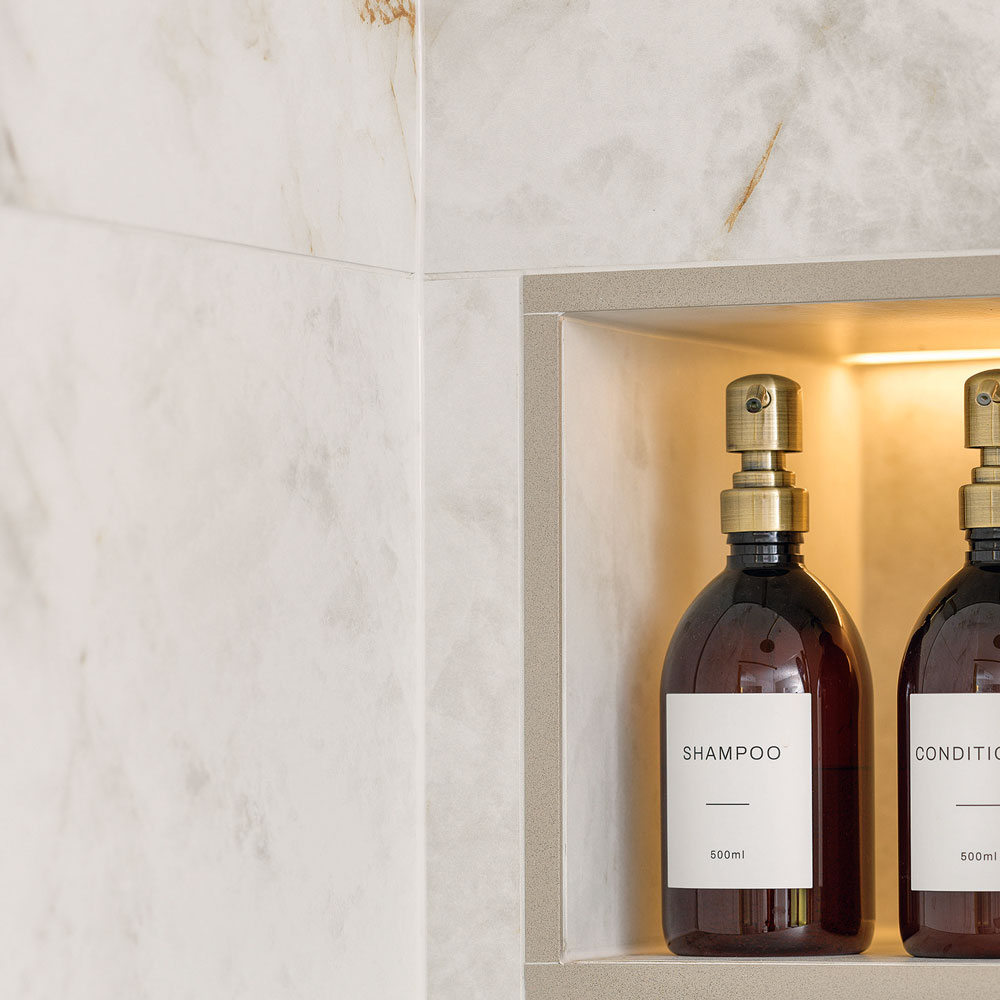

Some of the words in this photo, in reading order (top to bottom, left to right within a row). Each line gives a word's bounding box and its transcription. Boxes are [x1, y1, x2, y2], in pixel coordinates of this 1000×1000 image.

[682, 745, 781, 761] SHAMPOO
[710, 849, 745, 860] 500ml
[960, 851, 997, 862] 500ml
